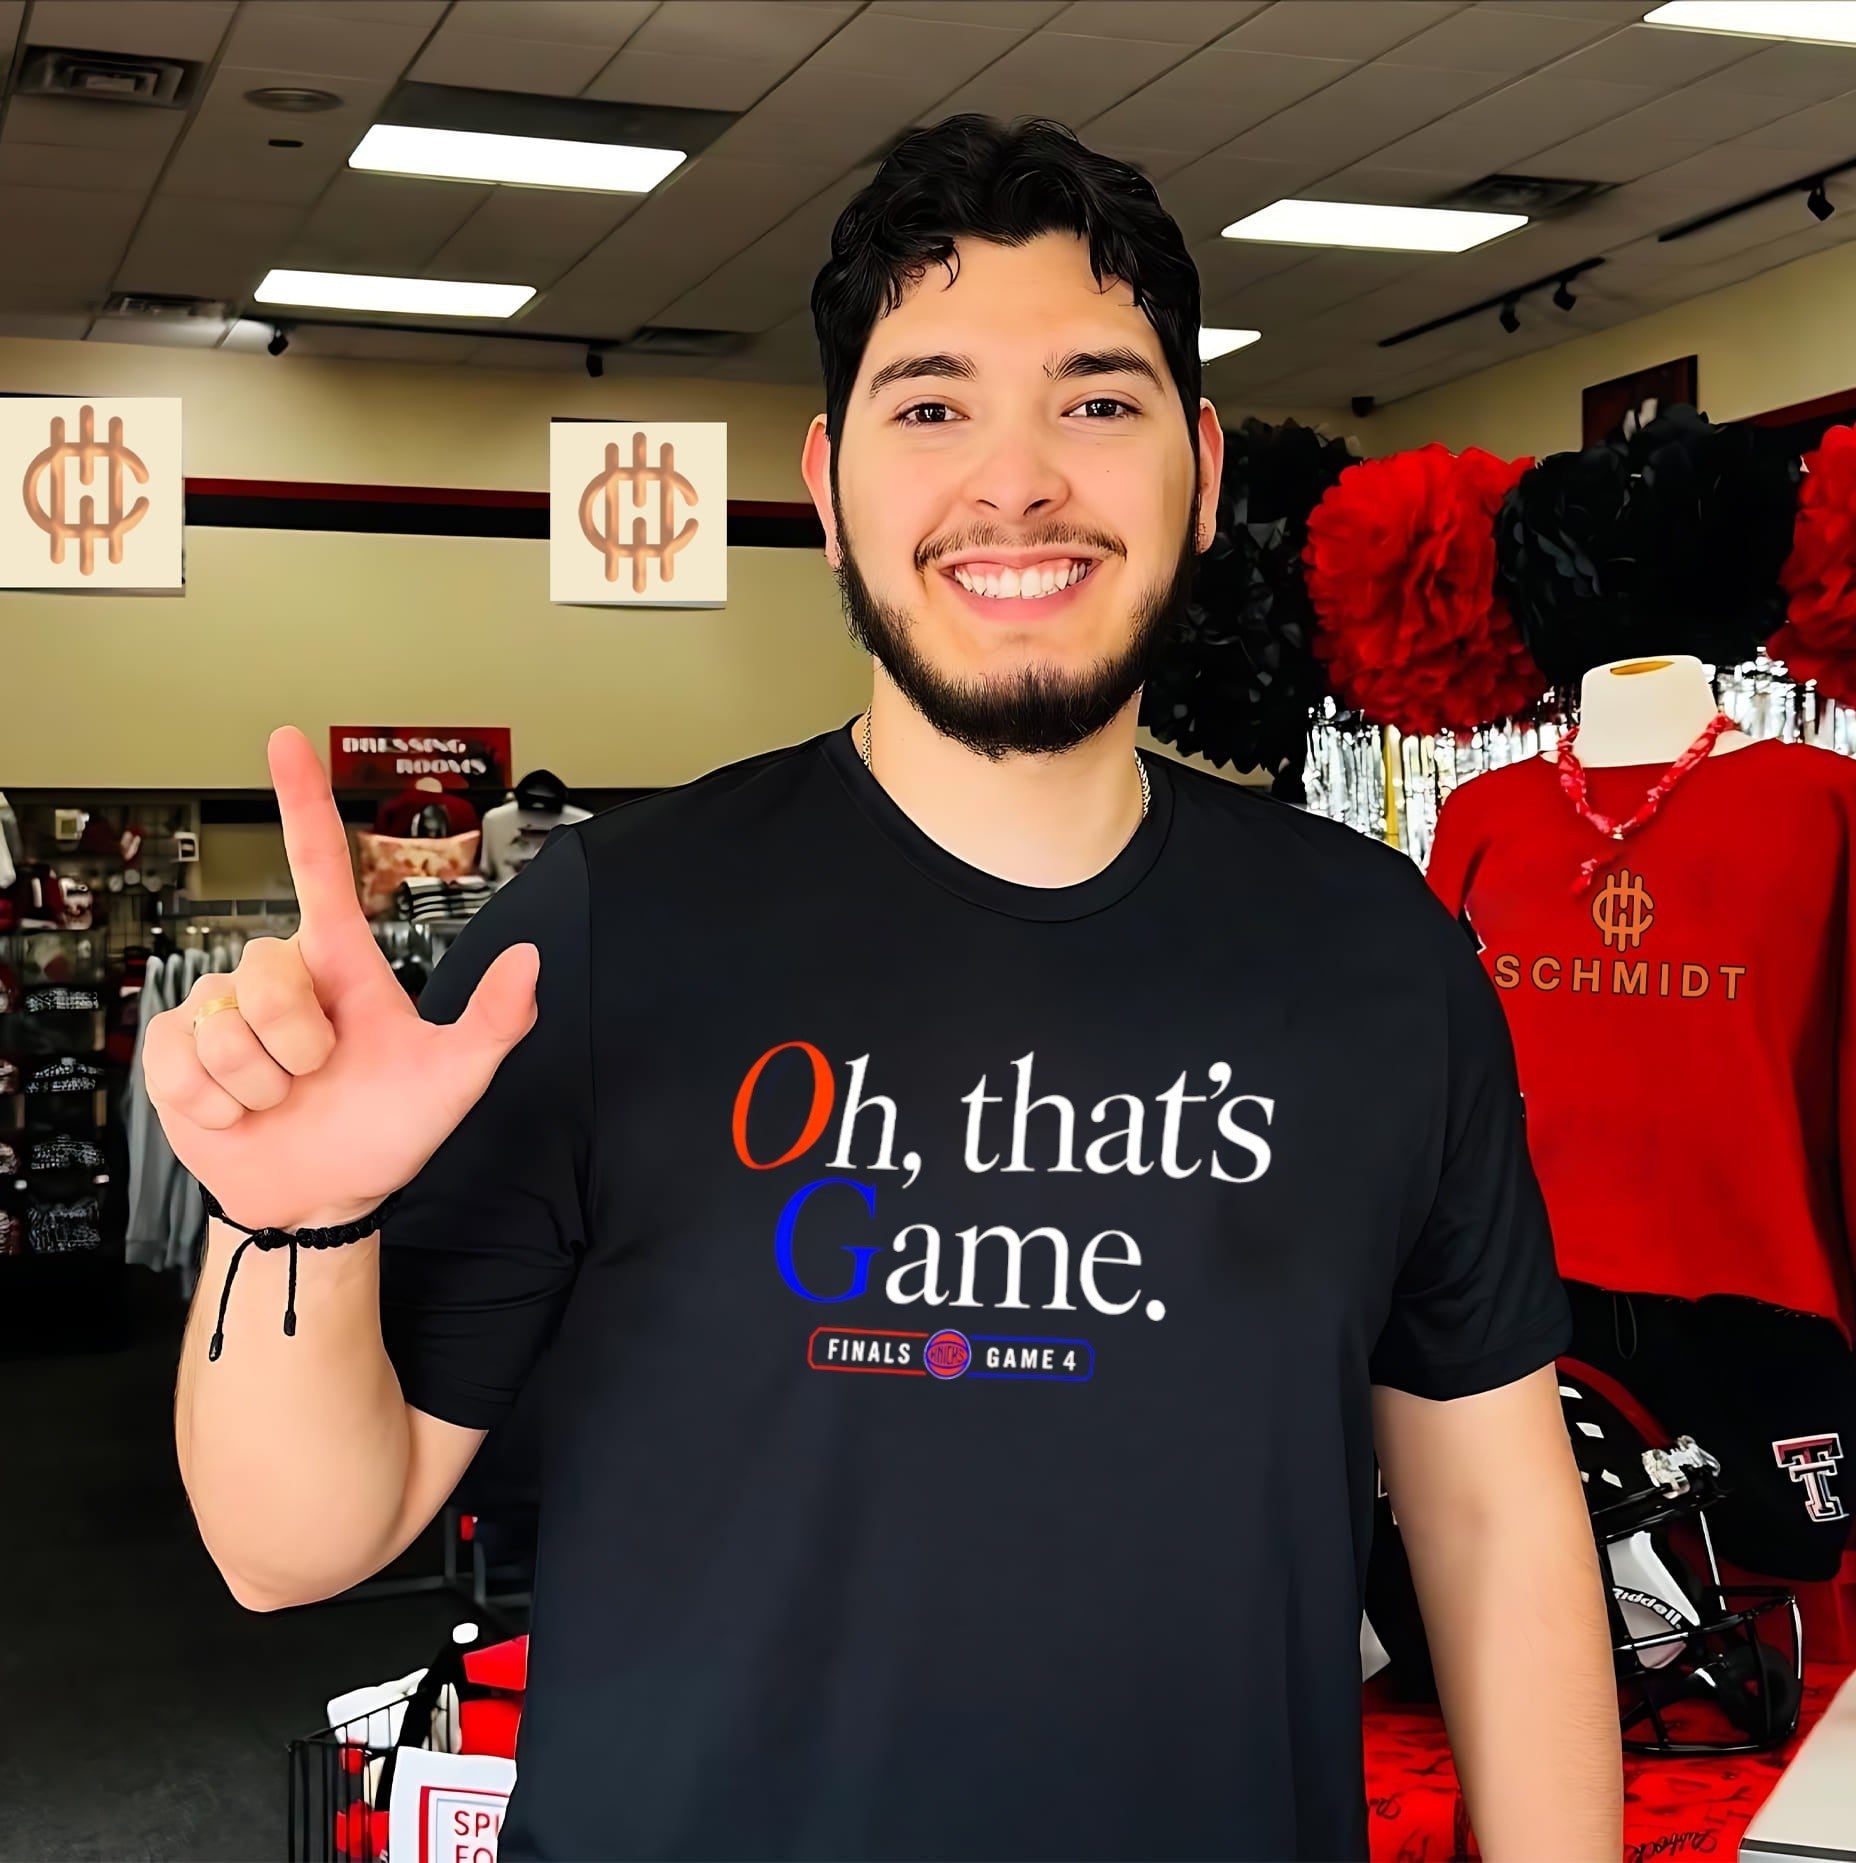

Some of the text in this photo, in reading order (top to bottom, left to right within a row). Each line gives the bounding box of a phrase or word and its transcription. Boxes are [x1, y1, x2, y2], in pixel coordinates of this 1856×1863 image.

[342, 737, 467, 754] DRESSING
[395, 758, 487, 775] ROOMS
[1494, 954, 1747, 1000] SCHMIDT
[731, 1040, 922, 1189] Oh,
[773, 1177, 1167, 1322] Game.
[827, 1338, 911, 1364] FINALS
[986, 1347, 1055, 1370] GAME
[1062, 1350, 1077, 1371] 4
